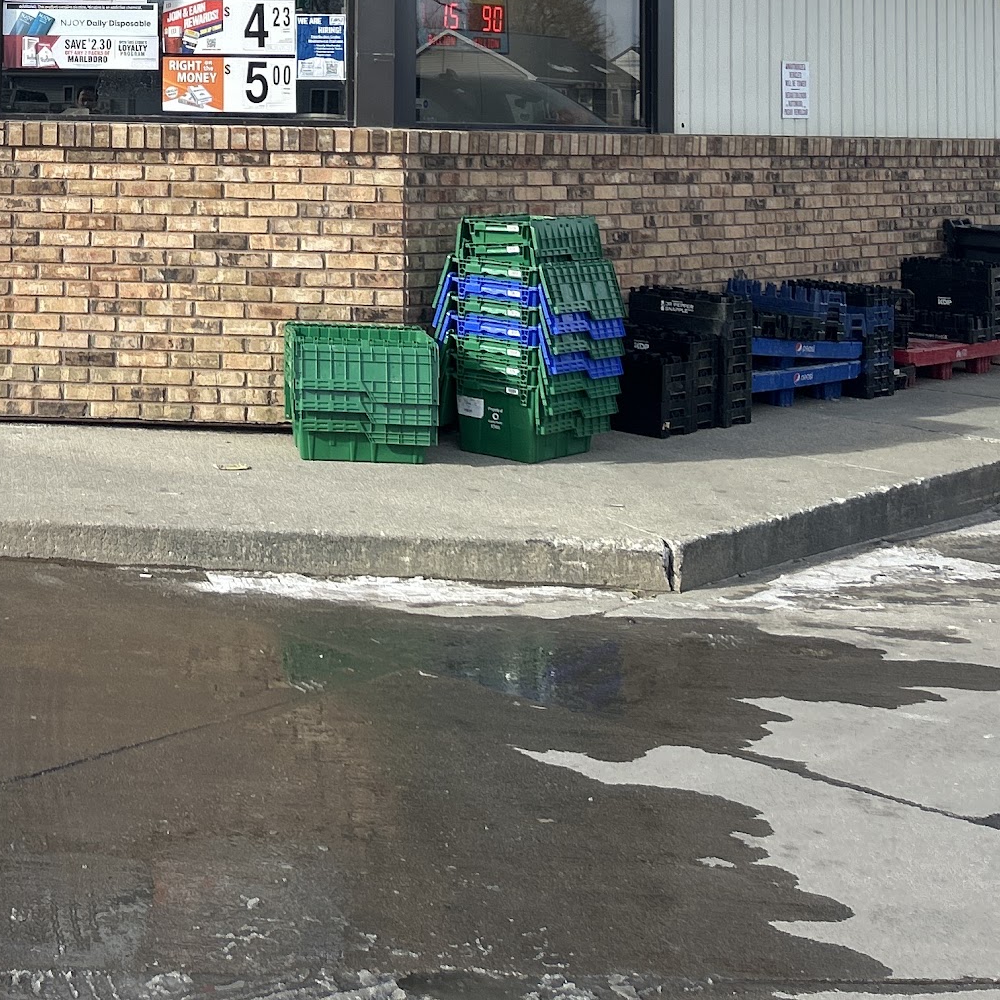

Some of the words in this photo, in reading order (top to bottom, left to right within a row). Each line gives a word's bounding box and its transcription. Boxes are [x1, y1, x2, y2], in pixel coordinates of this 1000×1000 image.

[167, 9, 182, 22] JOIN
[183, 8, 188, 18] &
[189, 2, 206, 16] EARN
[87, 20, 107, 28] Daily
[109, 20, 151, 28] Disposable
[184, 9, 219, 29] REWARDS!
[297, 17, 308, 25] WE
[309, 17, 322, 25] ARE
[482, 6, 503, 32] 90
[224, 7, 230, 17] $
[244, 3, 269, 48] 4
[273, 7, 291, 27] 23
[318, 26, 342, 34] HIRING!
[65, 40, 86, 50] SAVE
[169, 60, 202, 71] RIGHT
[177, 73, 217, 83] MONEY
[224, 65, 231, 74] $
[245, 61, 268, 103] 5
[273, 65, 291, 85] 00
